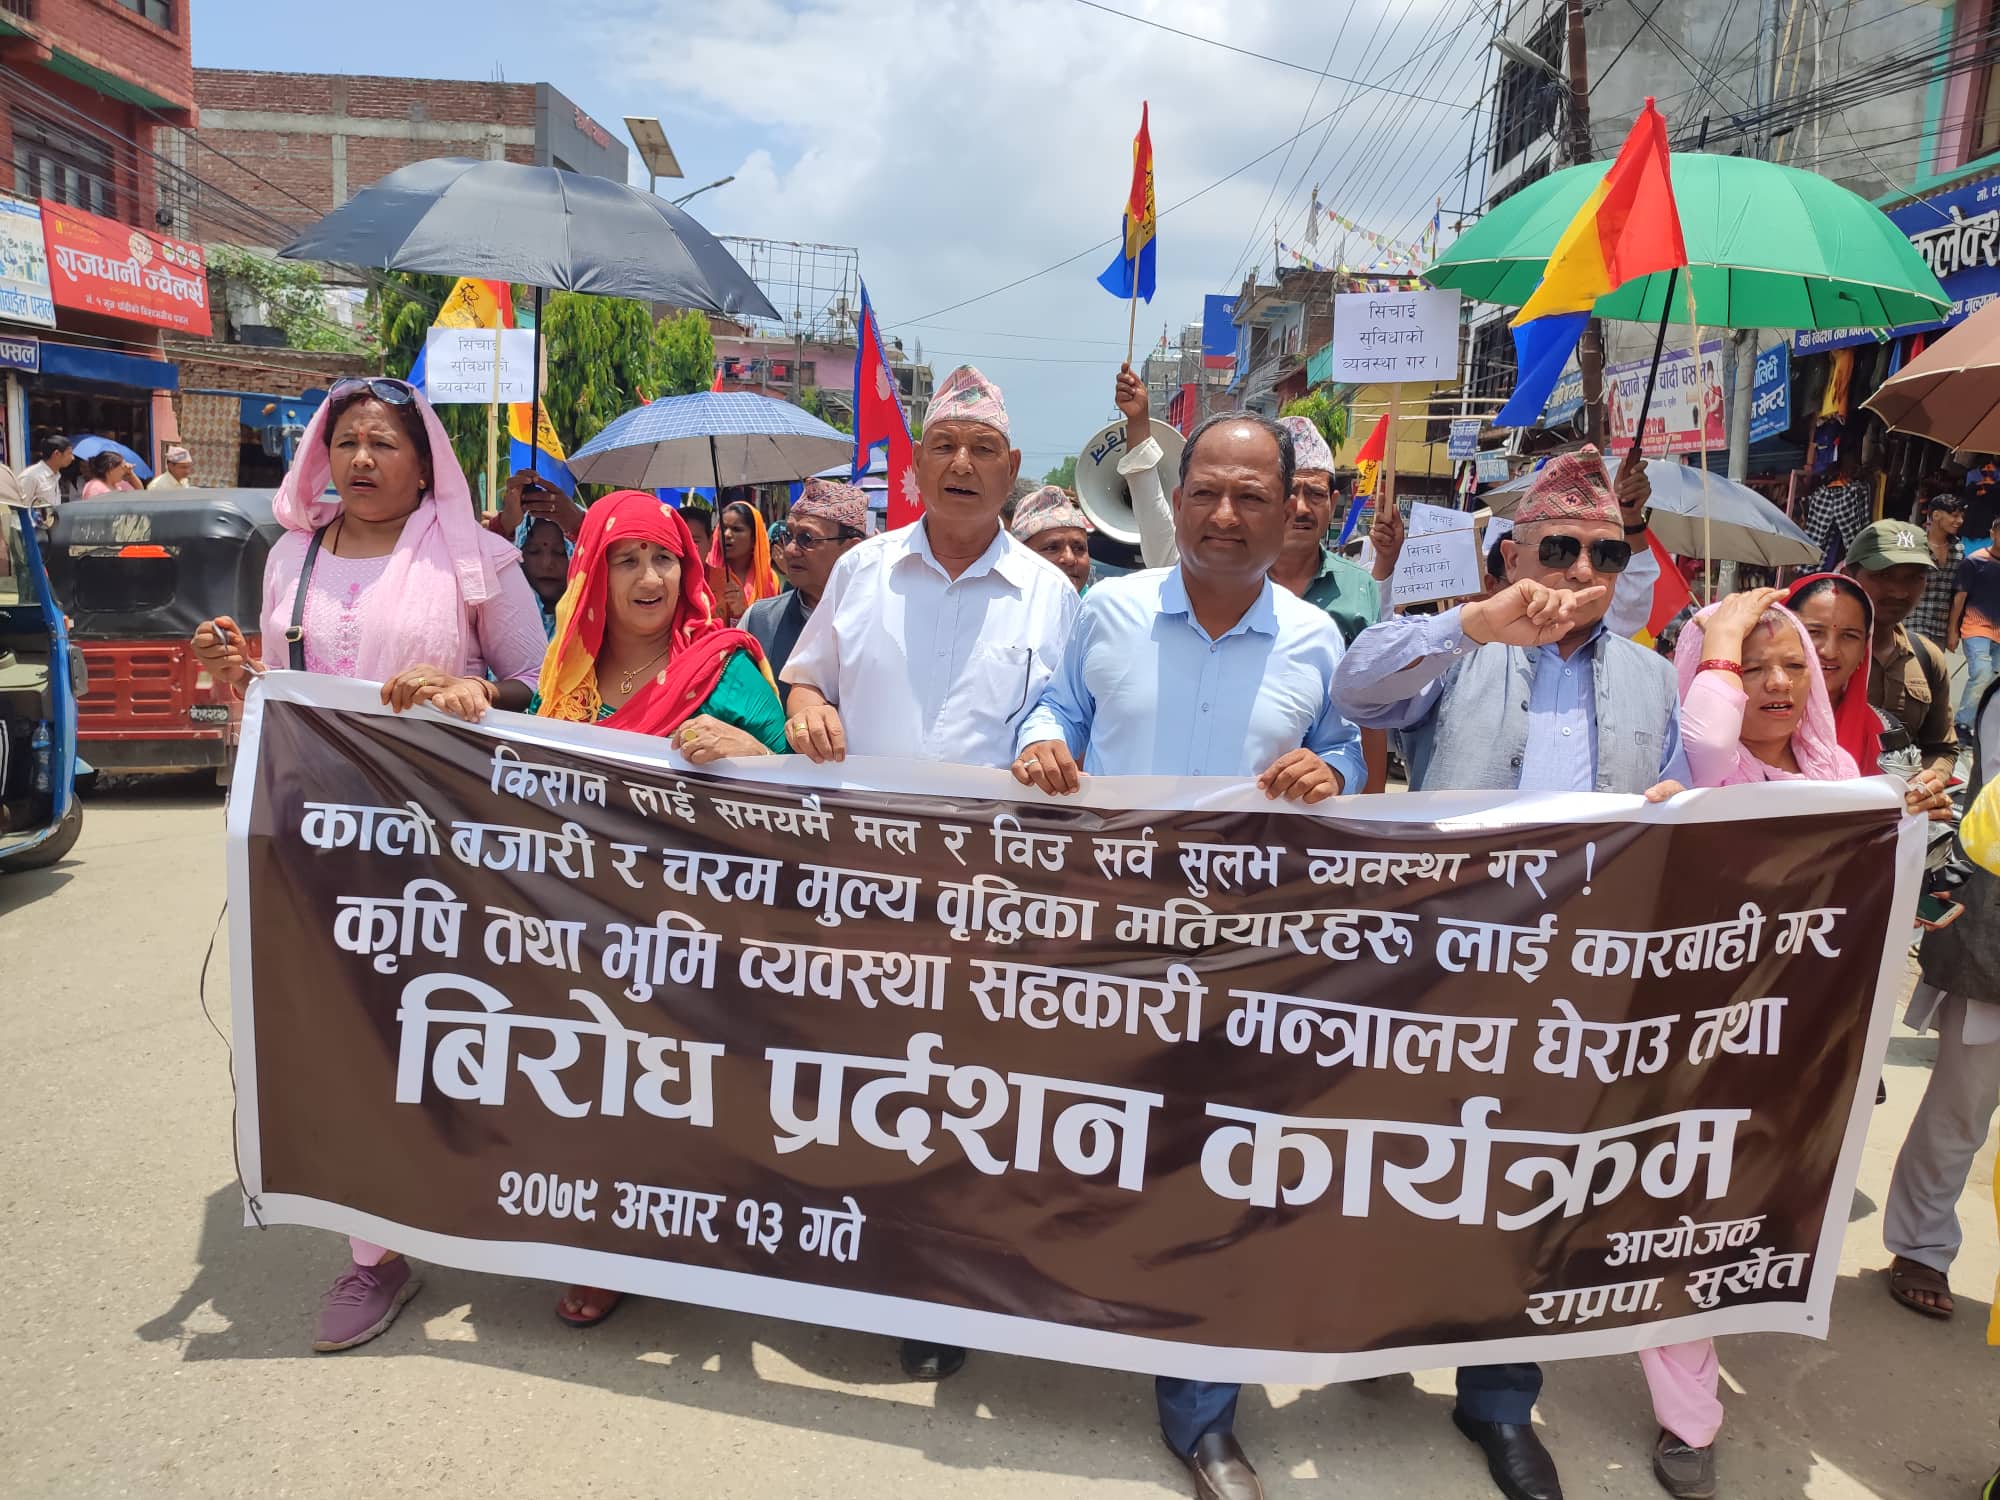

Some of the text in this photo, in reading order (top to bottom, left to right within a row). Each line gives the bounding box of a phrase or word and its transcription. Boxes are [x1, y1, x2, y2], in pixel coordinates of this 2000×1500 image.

[54, 245, 141, 287] राजधानी
[1360, 326, 1424, 351] सुविधाको
[1369, 298, 1416, 319] सिंचाई
[1342, 357, 1397, 371] व्यवस्था
[1405, 356, 1427, 369] गर
[490, 745, 608, 808] किसान
[622, 781, 695, 824] लाई
[711, 793, 833, 842] समयमै
[851, 814, 921, 855] मल
[938, 823, 972, 866] र
[990, 814, 1072, 872] विउ
[1092, 826, 1158, 880] सर्व
[1178, 841, 1287, 898] सुलभ
[1306, 848, 1470, 887] व्यवस्था
[1488, 849, 1557, 900] गर
[301, 800, 440, 856] कालो
[451, 821, 595, 880] बजारी
[611, 842, 647, 888] र
[663, 848, 783, 905] चरम
[797, 862, 921, 928] मुल्य
[1436, 913, 1558, 984] लाई
[1571, 902, 1766, 980] कारबाही
[1775, 907, 1846, 957] गर
[333, 878, 1788, 1083] कृषि तथा भुमि व्यवस्था सहकारी मन्त्रालय घेराउ तथा
[395, 972, 725, 1128] बिरोध
[1200, 1095, 1751, 1232] कार्यक्रम
[497, 1170, 866, 1263] २०७९ असार १३ गते
[1604, 1215, 1767, 1267] आयोजक
[1685, 1246, 1810, 1308] सुर्खेत
